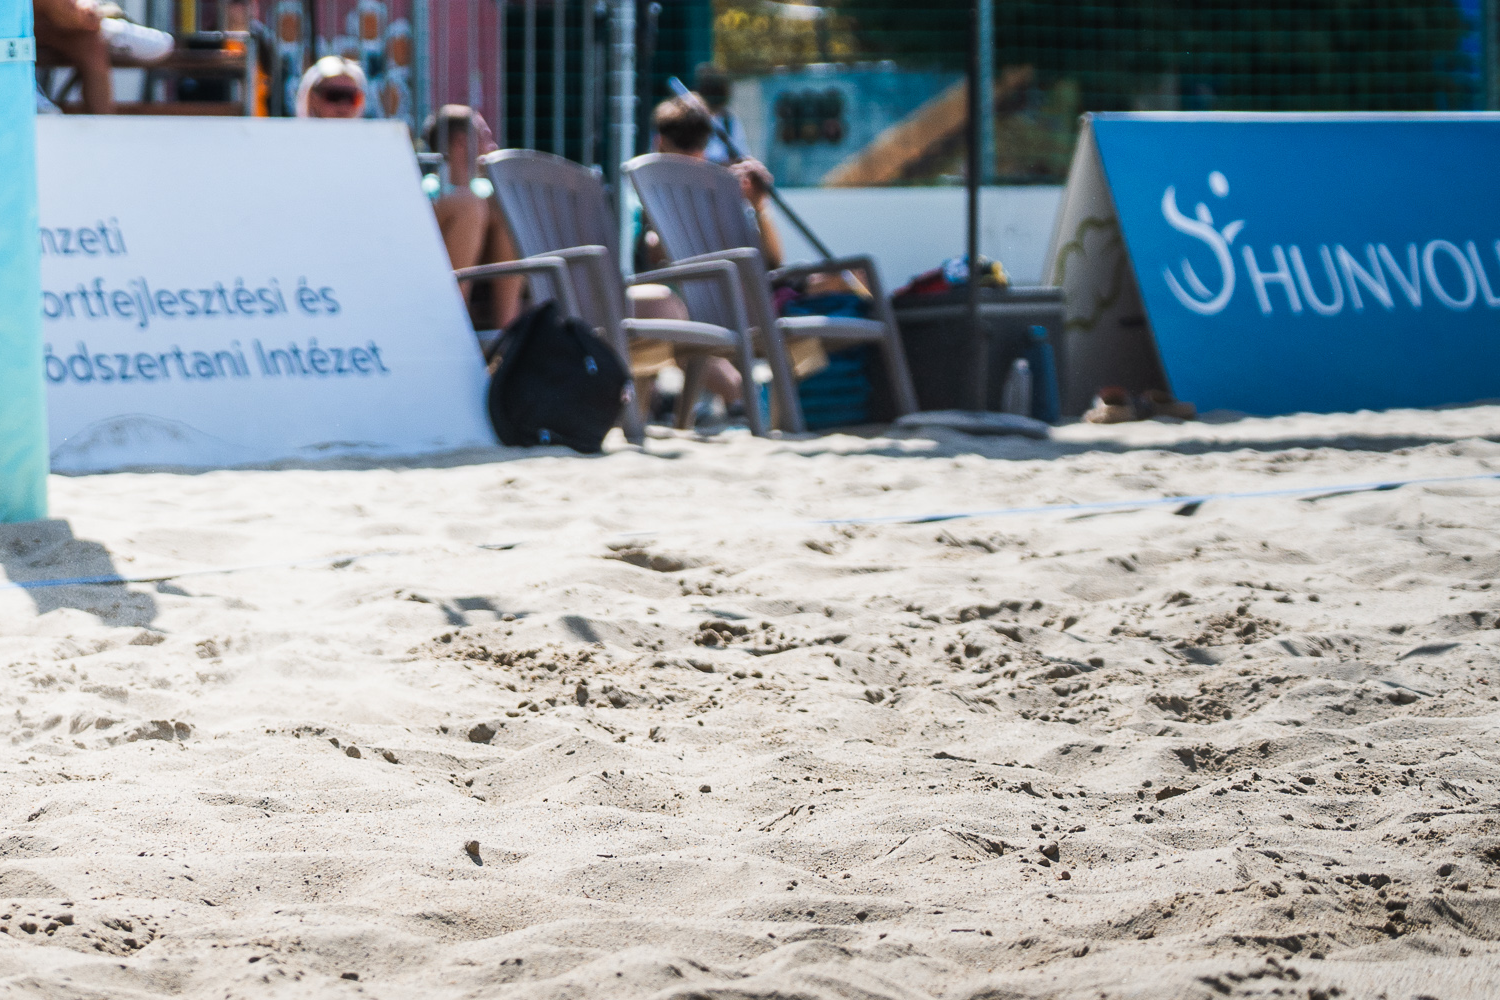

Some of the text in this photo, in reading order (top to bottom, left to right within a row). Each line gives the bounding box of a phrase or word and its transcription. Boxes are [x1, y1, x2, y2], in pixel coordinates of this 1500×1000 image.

[295, 275, 342, 316] és
[1241, 239, 1500, 317] HUNVOL
[252, 336, 390, 379] Intézet
